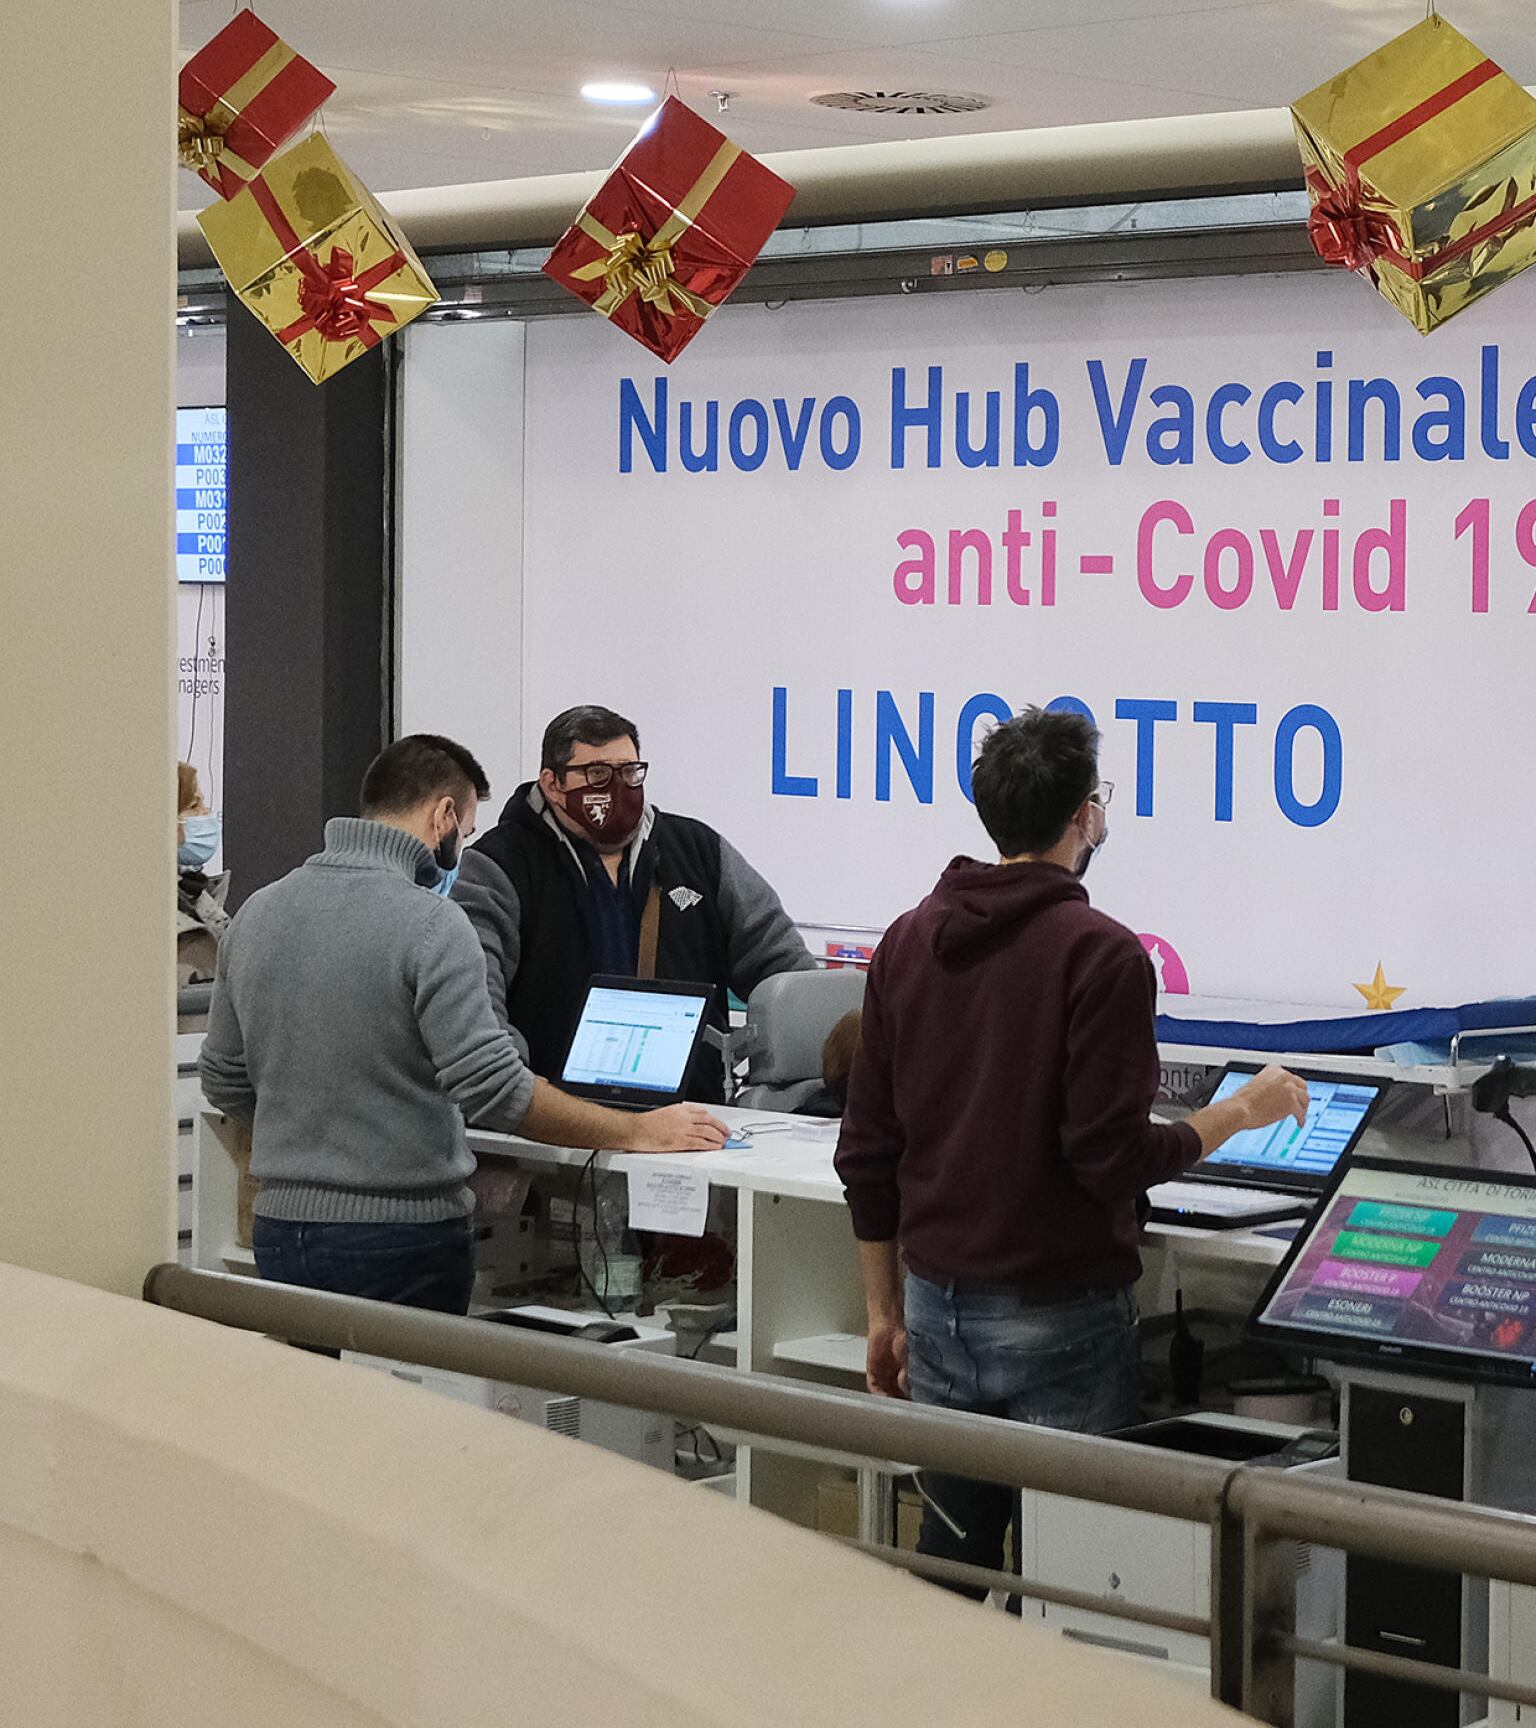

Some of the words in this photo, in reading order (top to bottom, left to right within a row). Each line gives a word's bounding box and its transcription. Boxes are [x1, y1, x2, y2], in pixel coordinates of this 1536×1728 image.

[619, 377, 861, 472] Nuovo
[890, 361, 1060, 469] Hub
[199, 557, 226, 575] P00
[771, 686, 1343, 828] LINTTO
[1480, 1252, 1536, 1269] MODERNA
[1461, 1283, 1512, 1300] BOOSTER
[1512, 1289, 1531, 1302] NP
[1327, 1298, 1373, 1313] ESONERI
